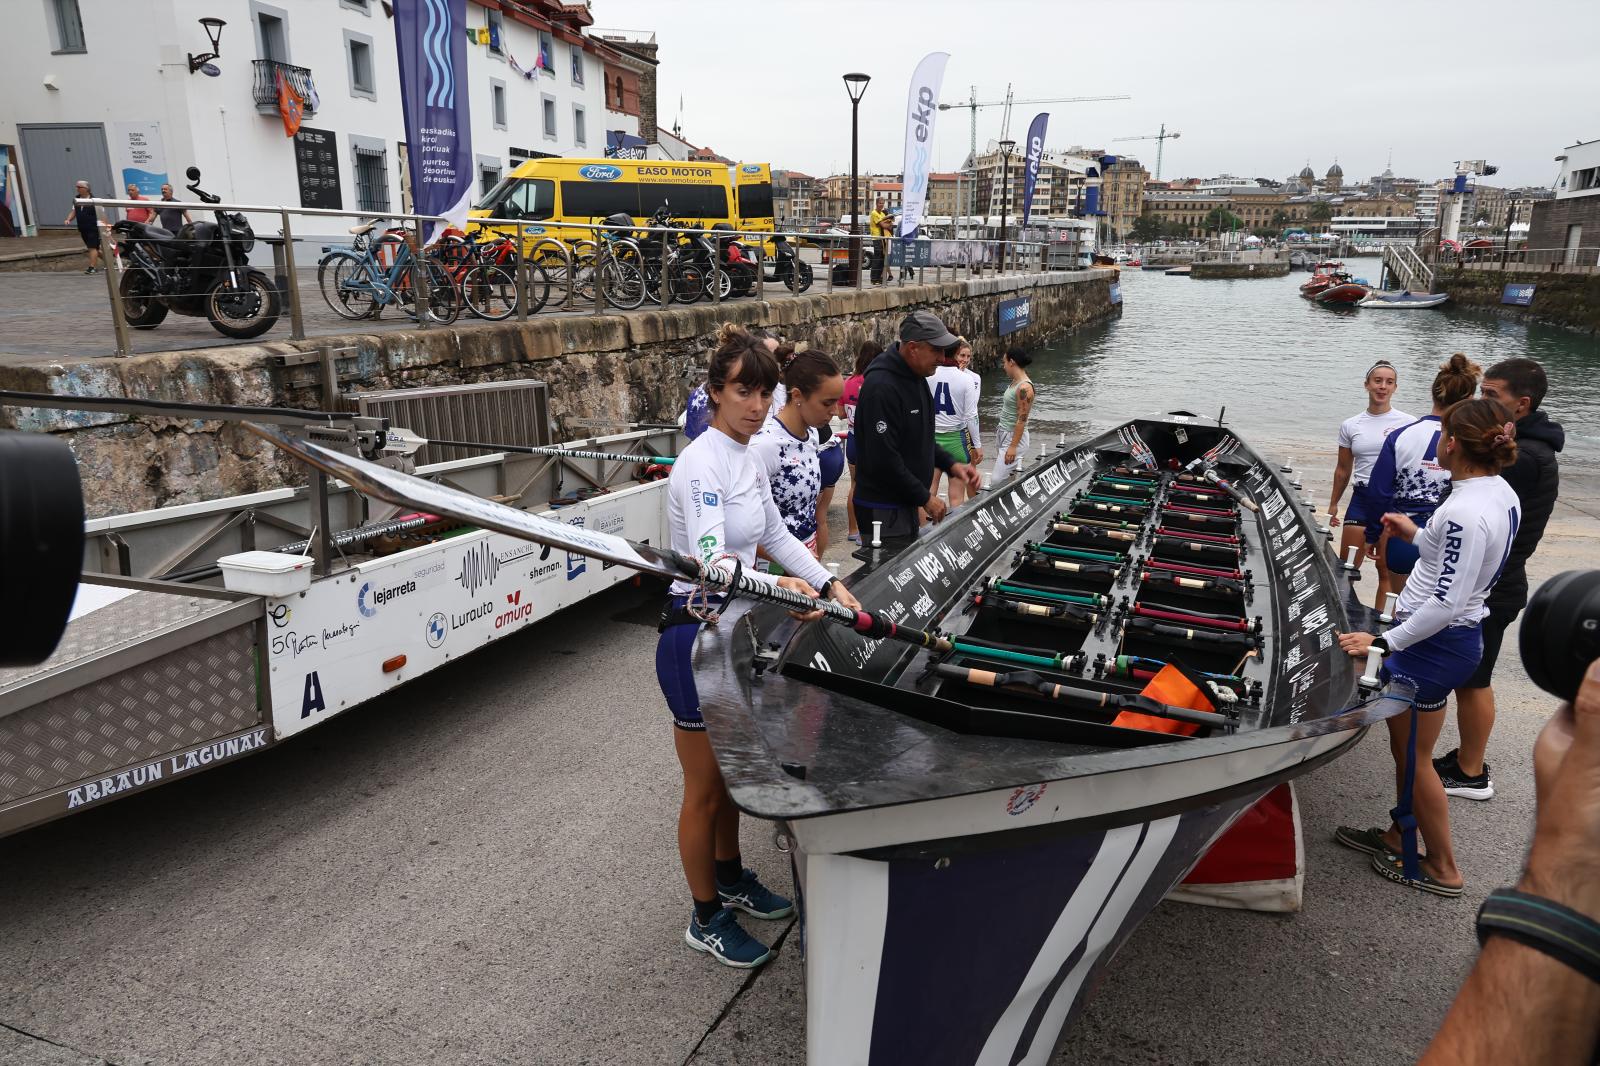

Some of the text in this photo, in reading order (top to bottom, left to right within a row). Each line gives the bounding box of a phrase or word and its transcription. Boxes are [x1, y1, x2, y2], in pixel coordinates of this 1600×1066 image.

[912, 86, 936, 143] ekp
[422, 145, 450, 153] portuak
[1028, 136, 1042, 174] ekp
[586, 166, 615, 179] Ford
[637, 167, 712, 177] EASO MOTOR
[532, 447, 572, 457] DONOSTIA
[574, 450, 608, 460] ARRAUN
[600, 516, 624, 530] BAVIERA
[500, 543, 534, 561] ENSANCHE
[1434, 520, 1464, 603] ARRAUN
[414, 562, 446, 579] seguridad
[373, 580, 416, 605] lejarreta
[451, 601, 494, 630] Lurauto
[494, 602, 533, 629] amura
[300, 670, 326, 720] A
[67, 730, 267, 809] ARRAUN LAGUNAK
